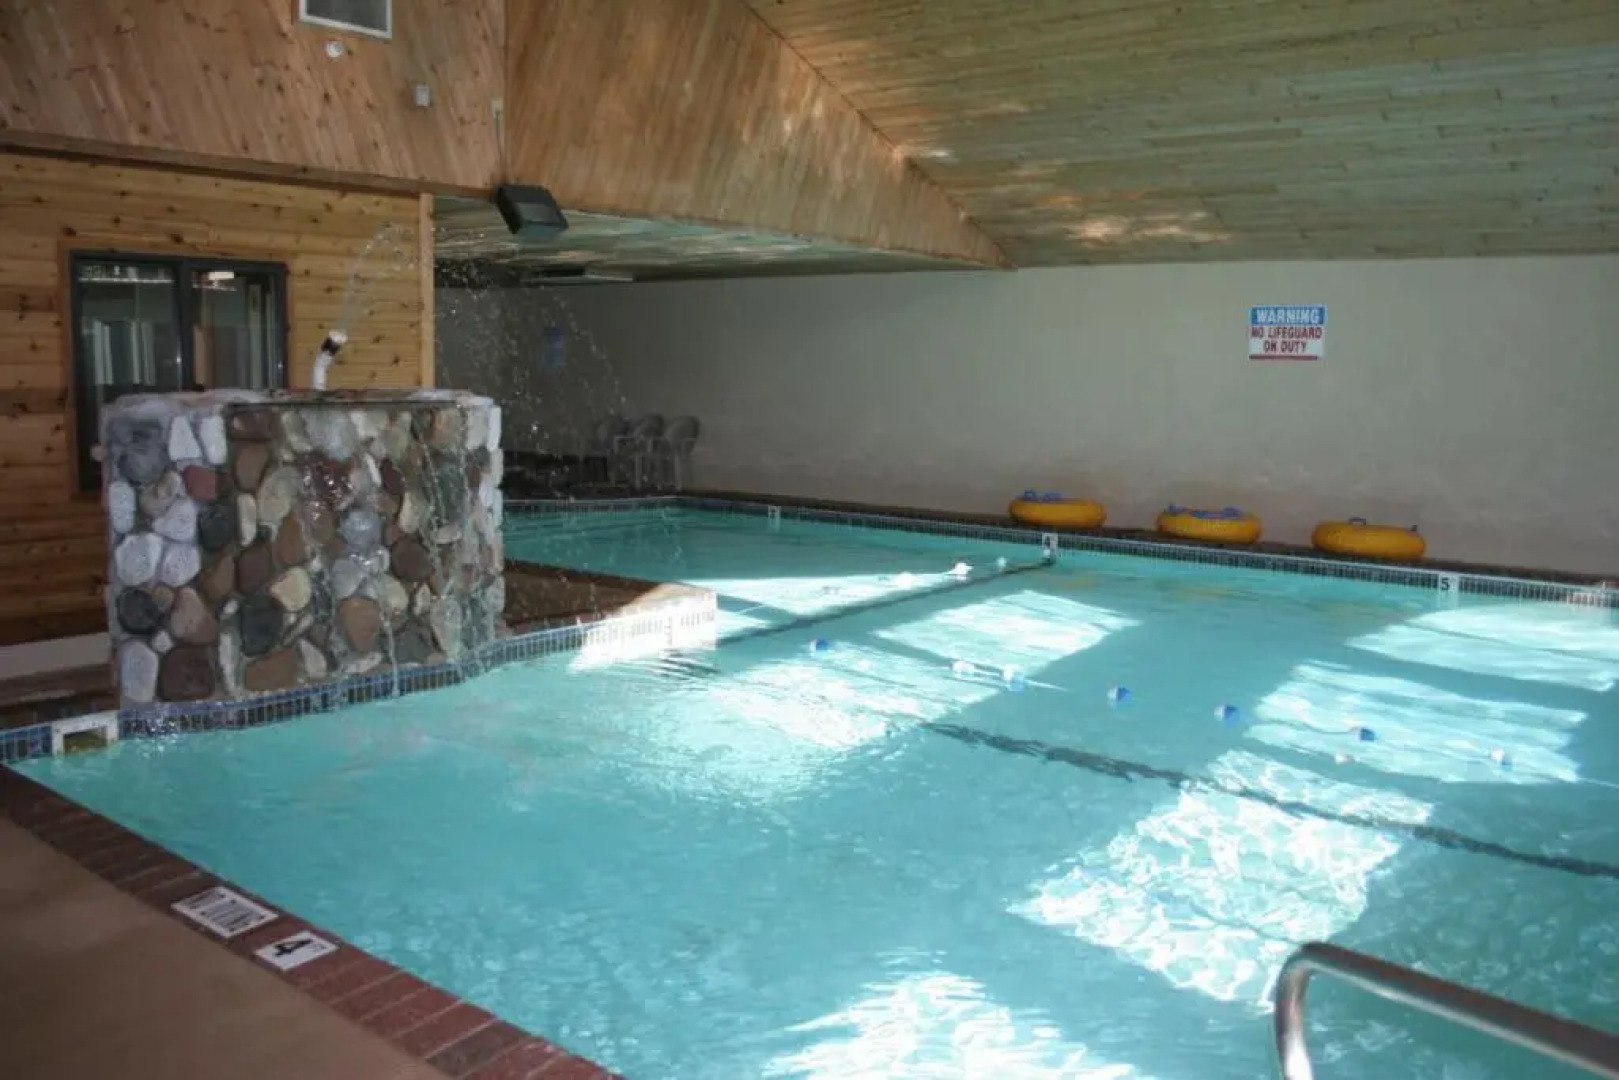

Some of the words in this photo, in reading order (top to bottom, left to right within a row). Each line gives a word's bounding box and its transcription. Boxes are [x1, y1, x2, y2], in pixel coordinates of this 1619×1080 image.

[1256, 308, 1321, 324] WARNING
[1251, 326, 1264, 339] NO
[1267, 326, 1323, 340] LIFEGUARD
[1263, 339, 1277, 352] ON
[1280, 340, 1308, 353] DUTY
[1441, 576, 1450, 591] 5
[273, 938, 313, 957] 4
